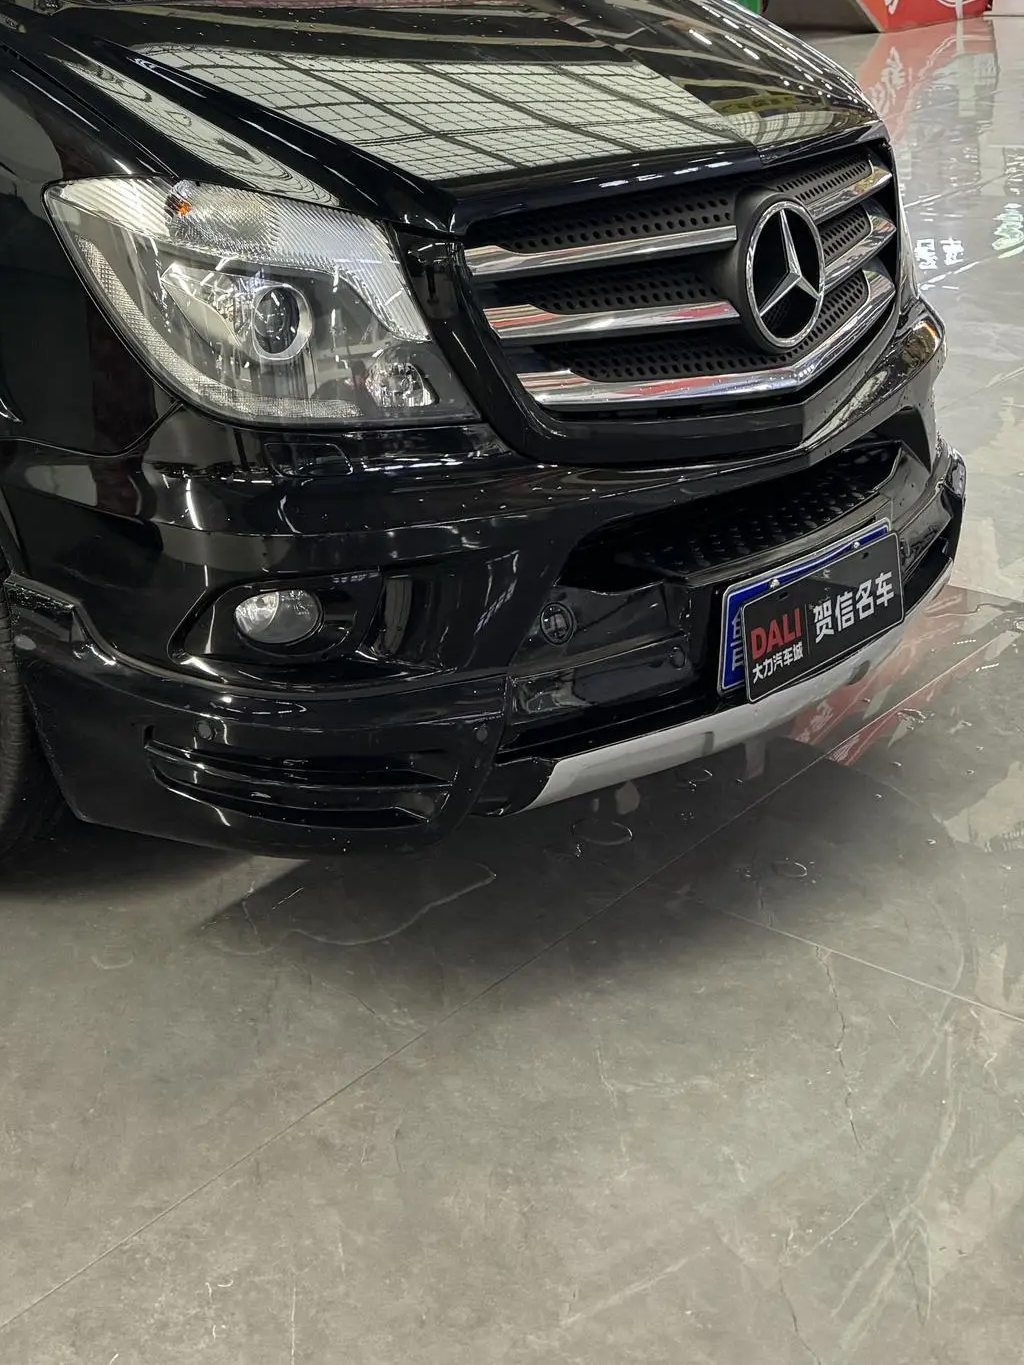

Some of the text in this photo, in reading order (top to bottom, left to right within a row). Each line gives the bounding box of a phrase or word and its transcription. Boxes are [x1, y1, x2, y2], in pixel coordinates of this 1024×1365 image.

[812, 570, 895, 643] 贺信名车
[750, 607, 803, 659] DALI
[752, 640, 804, 684] 大力汽车城
